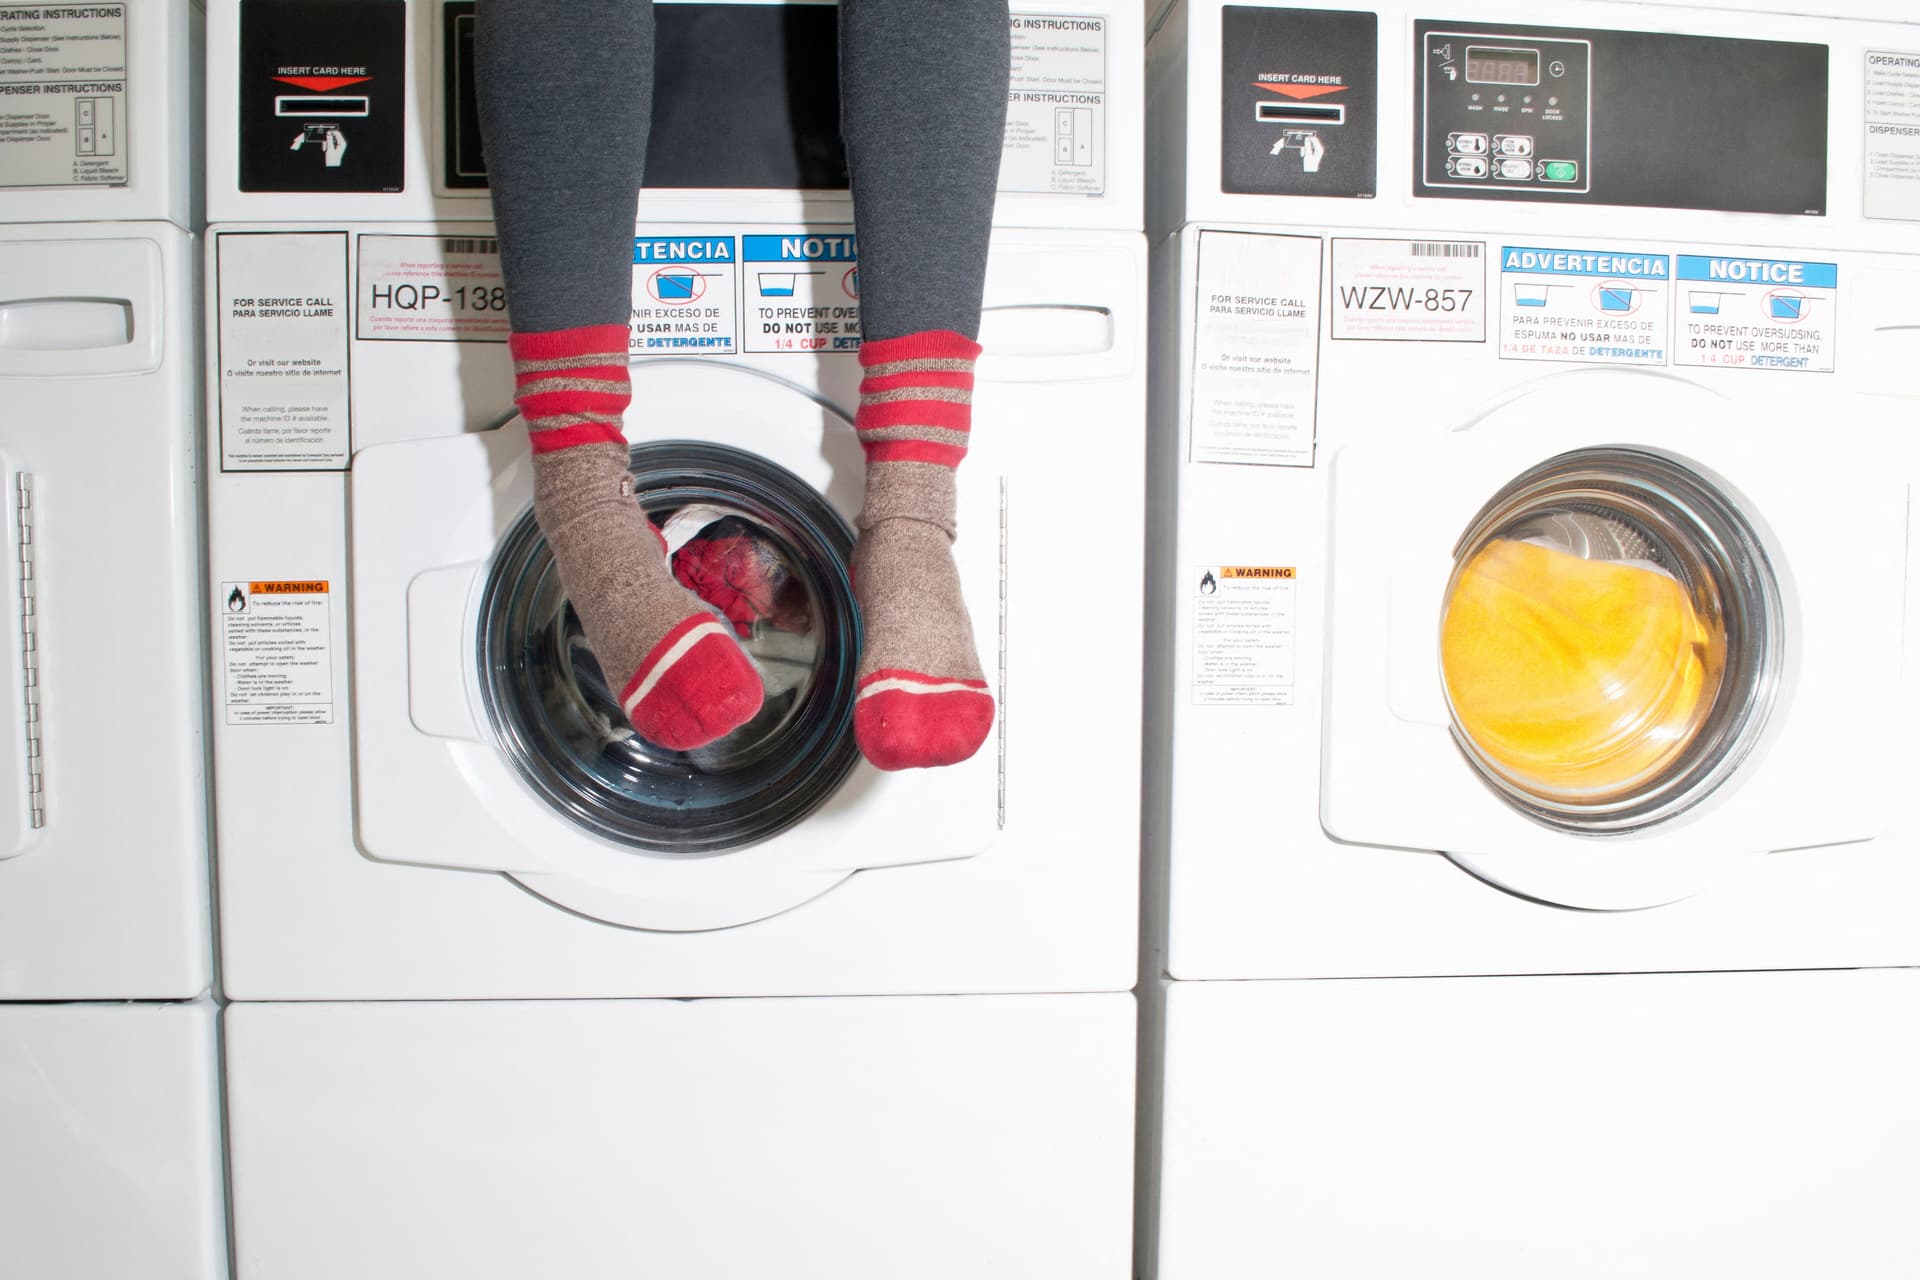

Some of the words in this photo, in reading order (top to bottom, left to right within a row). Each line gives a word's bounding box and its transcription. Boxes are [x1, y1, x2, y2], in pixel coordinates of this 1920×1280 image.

[43, 8, 122, 19] INSTRUCTIONS
[1024, 19, 1101, 31] INSTRUCTIONS
[278, 67, 310, 75] INSERT
[313, 67, 339, 75] CARD
[341, 67, 365, 75] HERE
[1258, 73, 1289, 83] INSERT
[1291, 74, 1316, 83] CARD
[1318, 75, 1342, 84] HERE
[43, 84, 122, 93] INSTRUCTIONS
[1024, 93, 1101, 104] INSTRUCTIONS
[1505, 251, 1665, 276] ADVERTENCIA
[1709, 259, 1804, 283] NOTICE
[234, 299, 255, 307] FOR
[258, 298, 303, 306] SERVICE
[306, 298, 333, 306] CALL
[372, 284, 506, 311] HQP-138
[1211, 295, 1231, 303] FOR
[1235, 296, 1277, 306] SERVICE
[1281, 299, 1306, 308] CALL
[1341, 286, 1473, 312] WZW-857
[233, 310, 256, 318] PARA
[258, 309, 300, 317] SERVICIO
[303, 309, 333, 317] LLAME
[655, 309, 701, 318] EXCESO
[705, 308, 720, 318] DE
[758, 308, 773, 318] TO
[777, 307, 829, 318] PREVENT
[1210, 306, 1232, 314] PARA
[1235, 307, 1275, 316] SERVICIO
[1277, 309, 1306, 318] LLAME
[637, 324, 671, 332] USAR
[675, 323, 699, 332] MAS
[703, 323, 718, 332] DE
[763, 323, 780, 333] DO
[786, 323, 811, 333] NOT
[815, 322, 839, 333] USE
[1513, 316, 1539, 325] PARA
[1543, 317, 1593, 327] PREVENIR
[1597, 320, 1637, 330] EXCESO
[1640, 321, 1653, 330] DE
[1689, 324, 1700, 334] TO
[1704, 325, 1749, 337] PREVENT
[629, 339, 644, 348] DE
[647, 337, 731, 347] DETERGENTE
[1514, 330, 1557, 340] ESPUMA
[1560, 332, 1576, 341] NO
[1580, 333, 1610, 342] USAR
[1613, 334, 1635, 344] MAS
[1638, 335, 1651, 344] DE
[776, 339, 792, 349] 1/4
[800, 338, 828, 349] CUP
[1691, 339, 1706, 348] DO
[1710, 339, 1733, 350] NOT
[1736, 341, 1755, 351] USE
[1761, 342, 1788, 352] MORE
[1794, 343, 1819, 354] THAN
[1522, 345, 1536, 353] DE
[1541, 345, 1569, 354] TAZA
[1572, 346, 1585, 356] DE
[1589, 347, 1663, 359] DETERGENTE
[1264, 356, 1292, 364] website
[1723, 354, 1745, 364] CUP
[1750, 355, 1809, 368] DETERGENT
[1236, 568, 1291, 577] WARNING
[264, 583, 323, 592] WARNING
